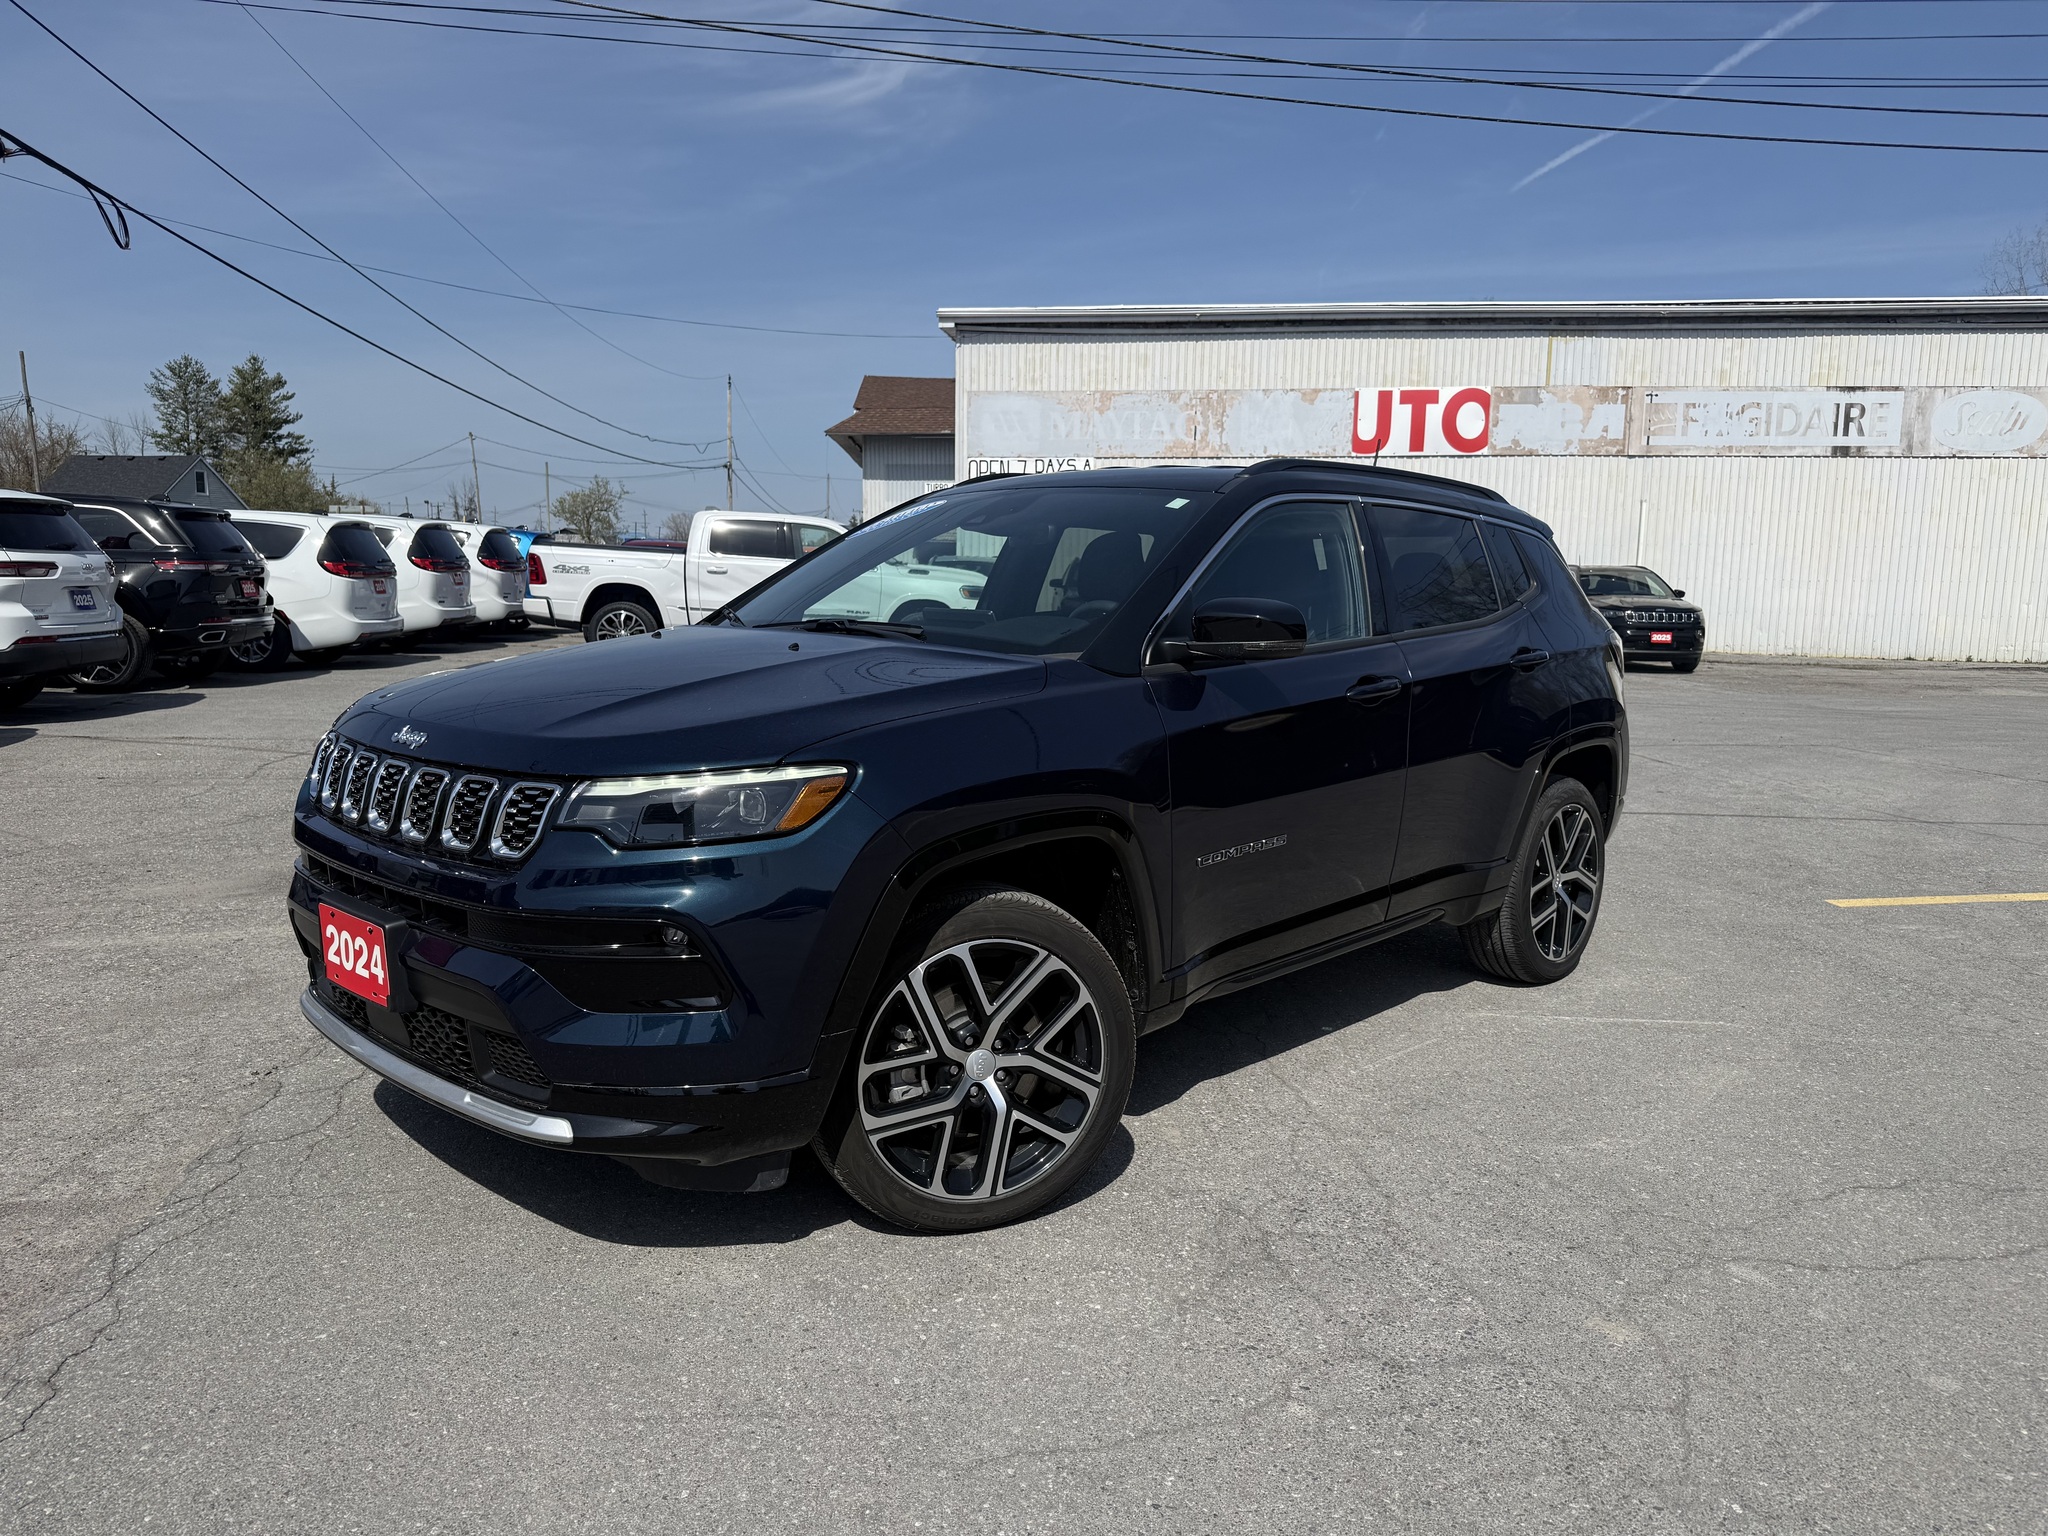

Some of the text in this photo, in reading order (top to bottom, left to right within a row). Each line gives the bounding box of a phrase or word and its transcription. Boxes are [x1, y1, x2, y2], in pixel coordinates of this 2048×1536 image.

[1351, 387, 1490, 455] UTO
[1680, 402, 1891, 438] FGIDAIRE
[73, 594, 94, 606] 2025
[390, 724, 428, 750] Jeep
[1196, 834, 1288, 868] COMPASS
[325, 924, 385, 986] 2024
